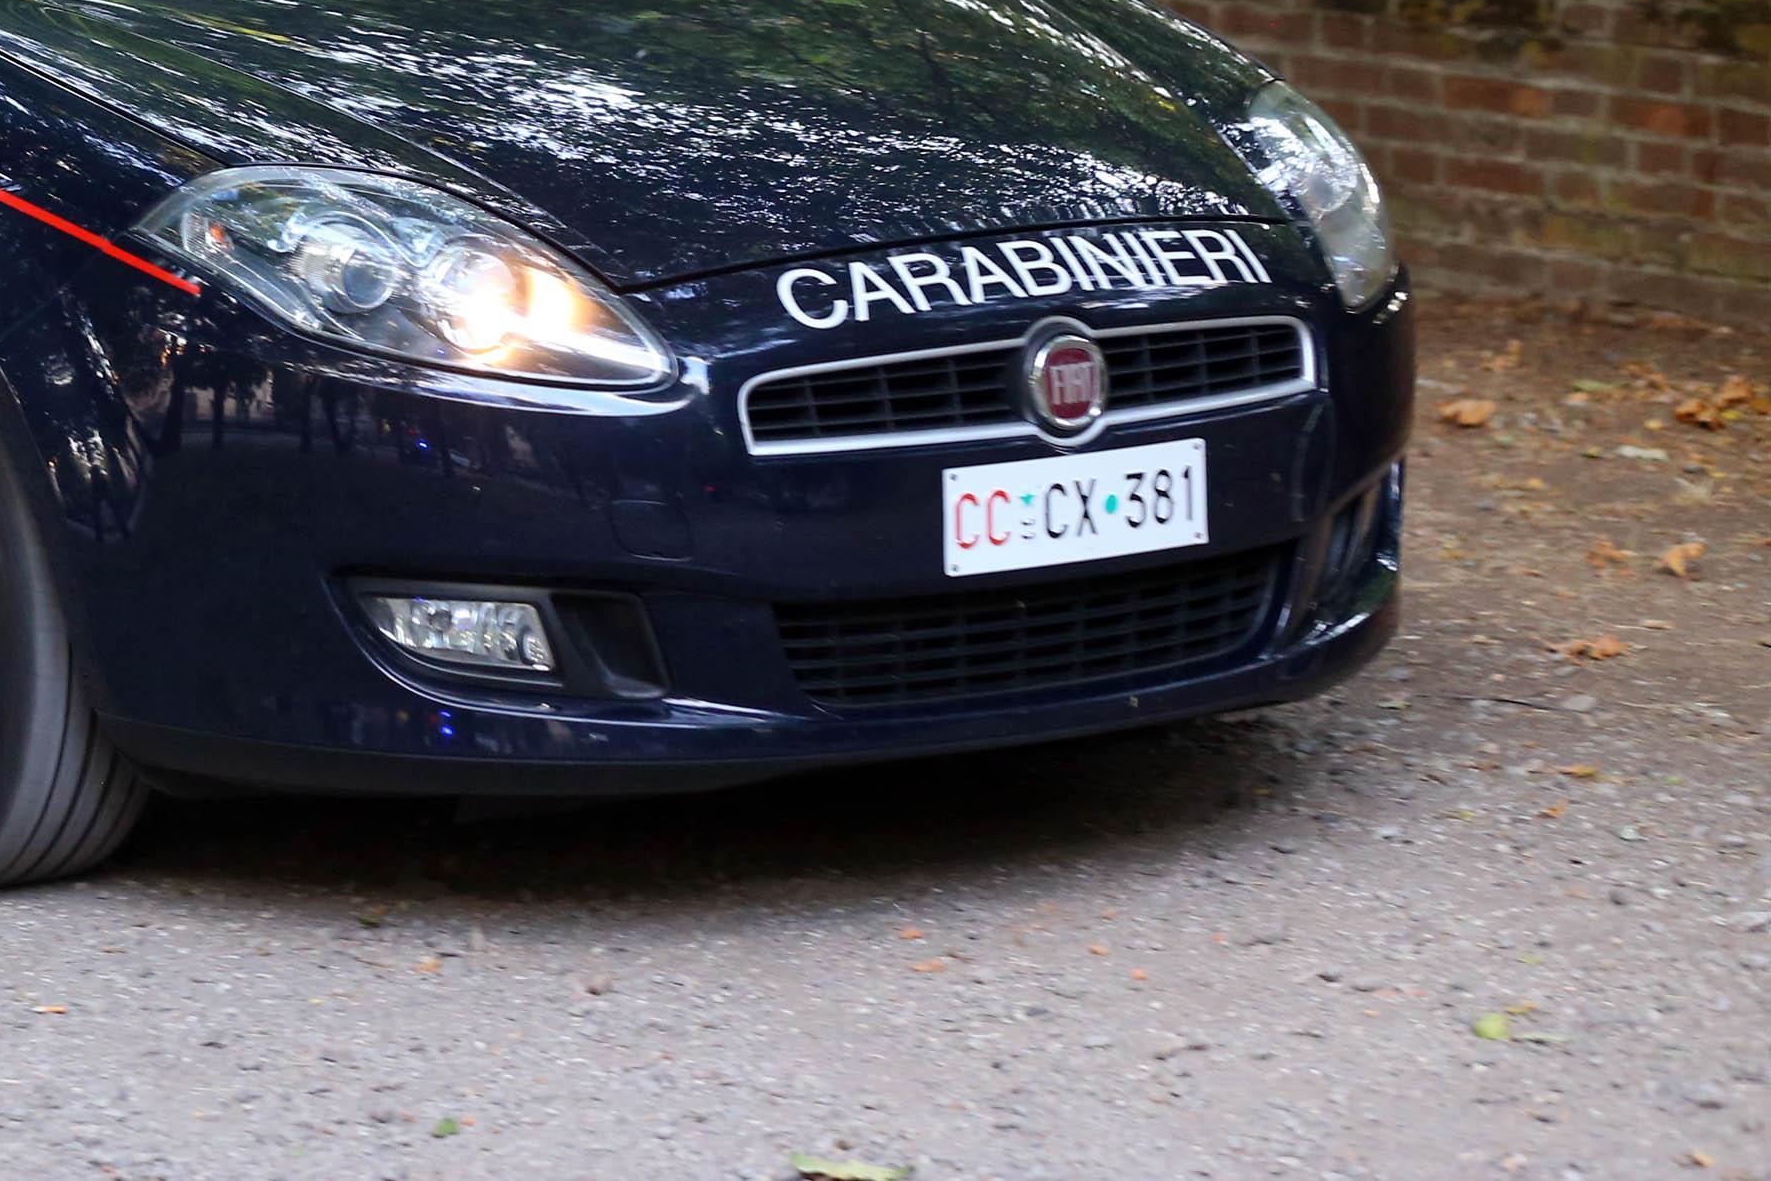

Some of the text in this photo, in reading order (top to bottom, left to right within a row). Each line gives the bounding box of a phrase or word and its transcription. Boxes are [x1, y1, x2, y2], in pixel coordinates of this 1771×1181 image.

[776, 228, 1273, 329] CARABINIERI
[1049, 362, 1096, 405] FIAT
[954, 466, 1194, 549] CC CX 381
